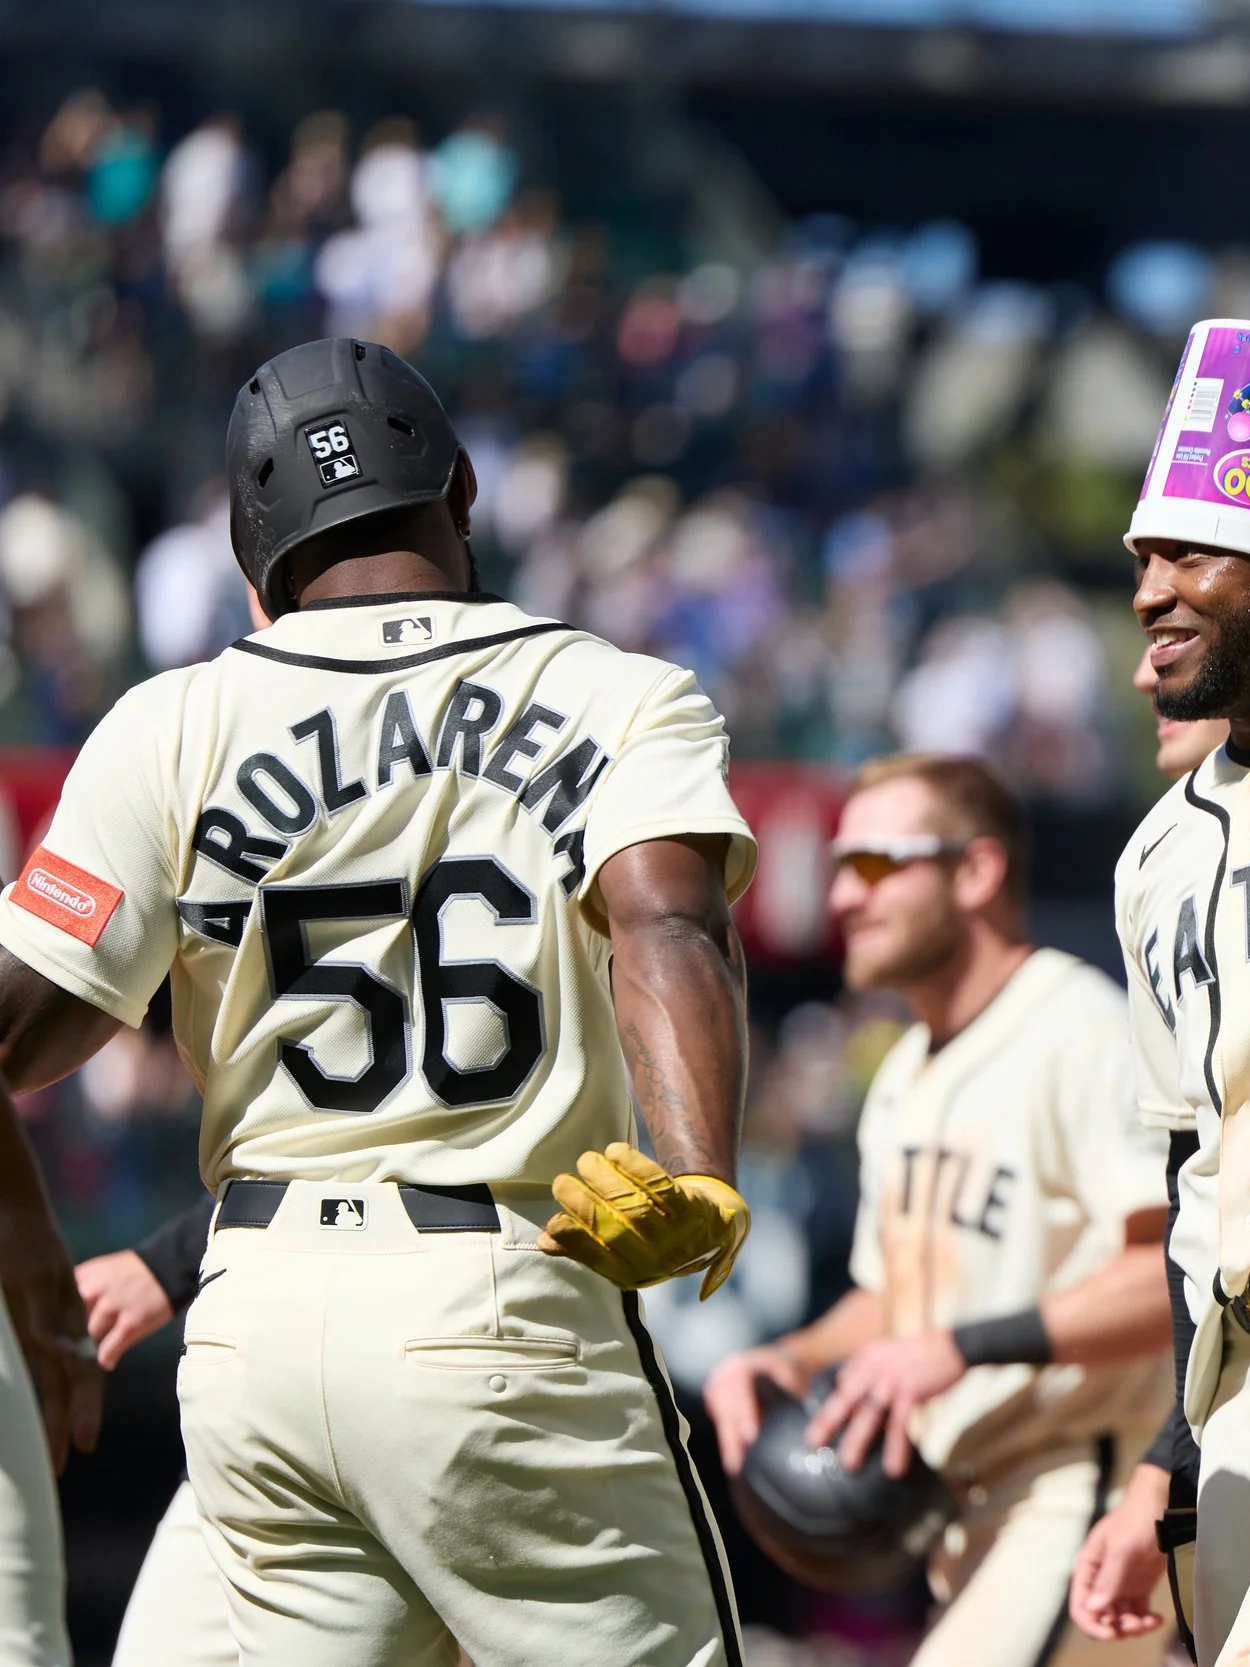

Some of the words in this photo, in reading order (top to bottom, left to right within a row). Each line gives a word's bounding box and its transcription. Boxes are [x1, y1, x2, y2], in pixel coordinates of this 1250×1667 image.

[309, 425, 350, 459] 56
[31, 872, 88, 911] Nintendo
[257, 852, 545, 1113] 56
